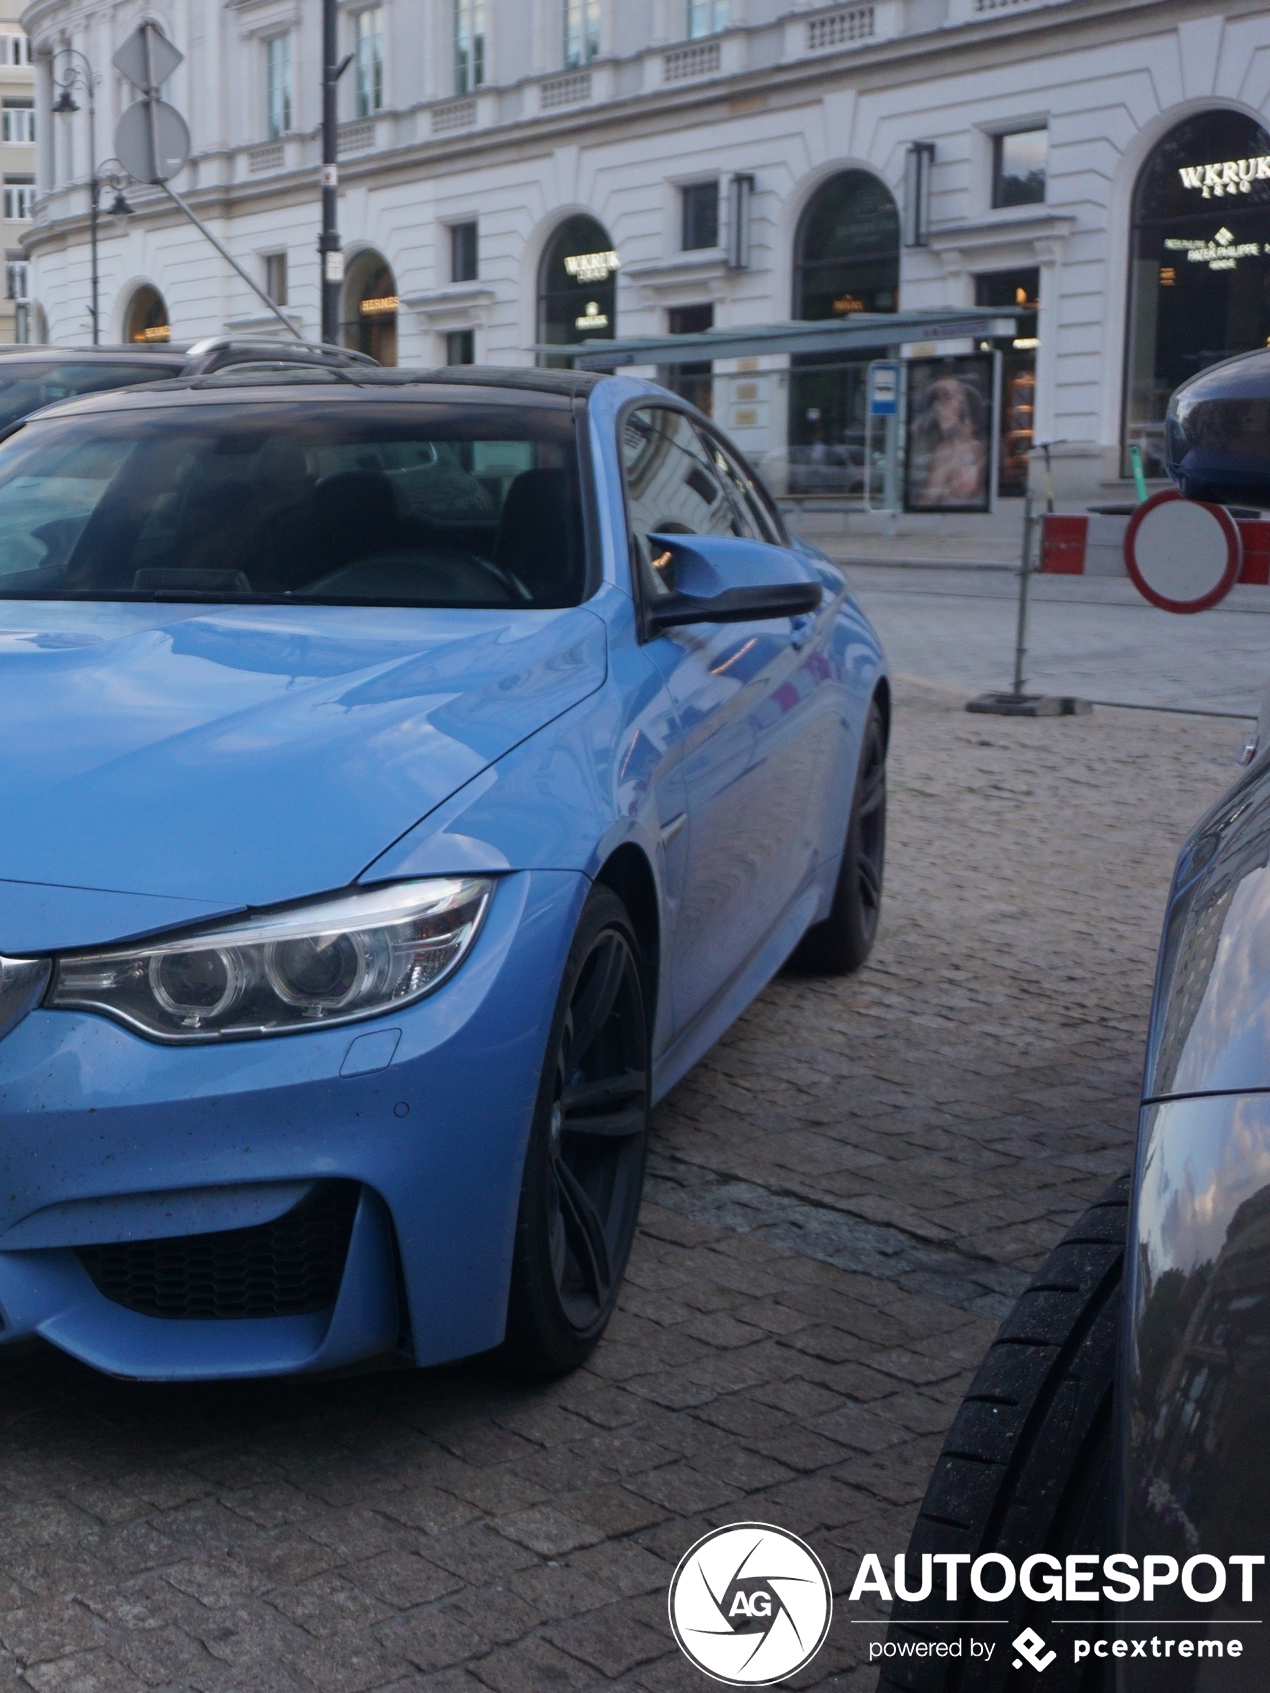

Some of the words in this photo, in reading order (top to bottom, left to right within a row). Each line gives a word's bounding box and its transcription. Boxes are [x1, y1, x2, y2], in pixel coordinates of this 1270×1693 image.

[1201, 180, 1251, 199] 1840
[1187, 247, 1217, 262] PATEK
[1217, 243, 1260, 259] PHILIPPE
